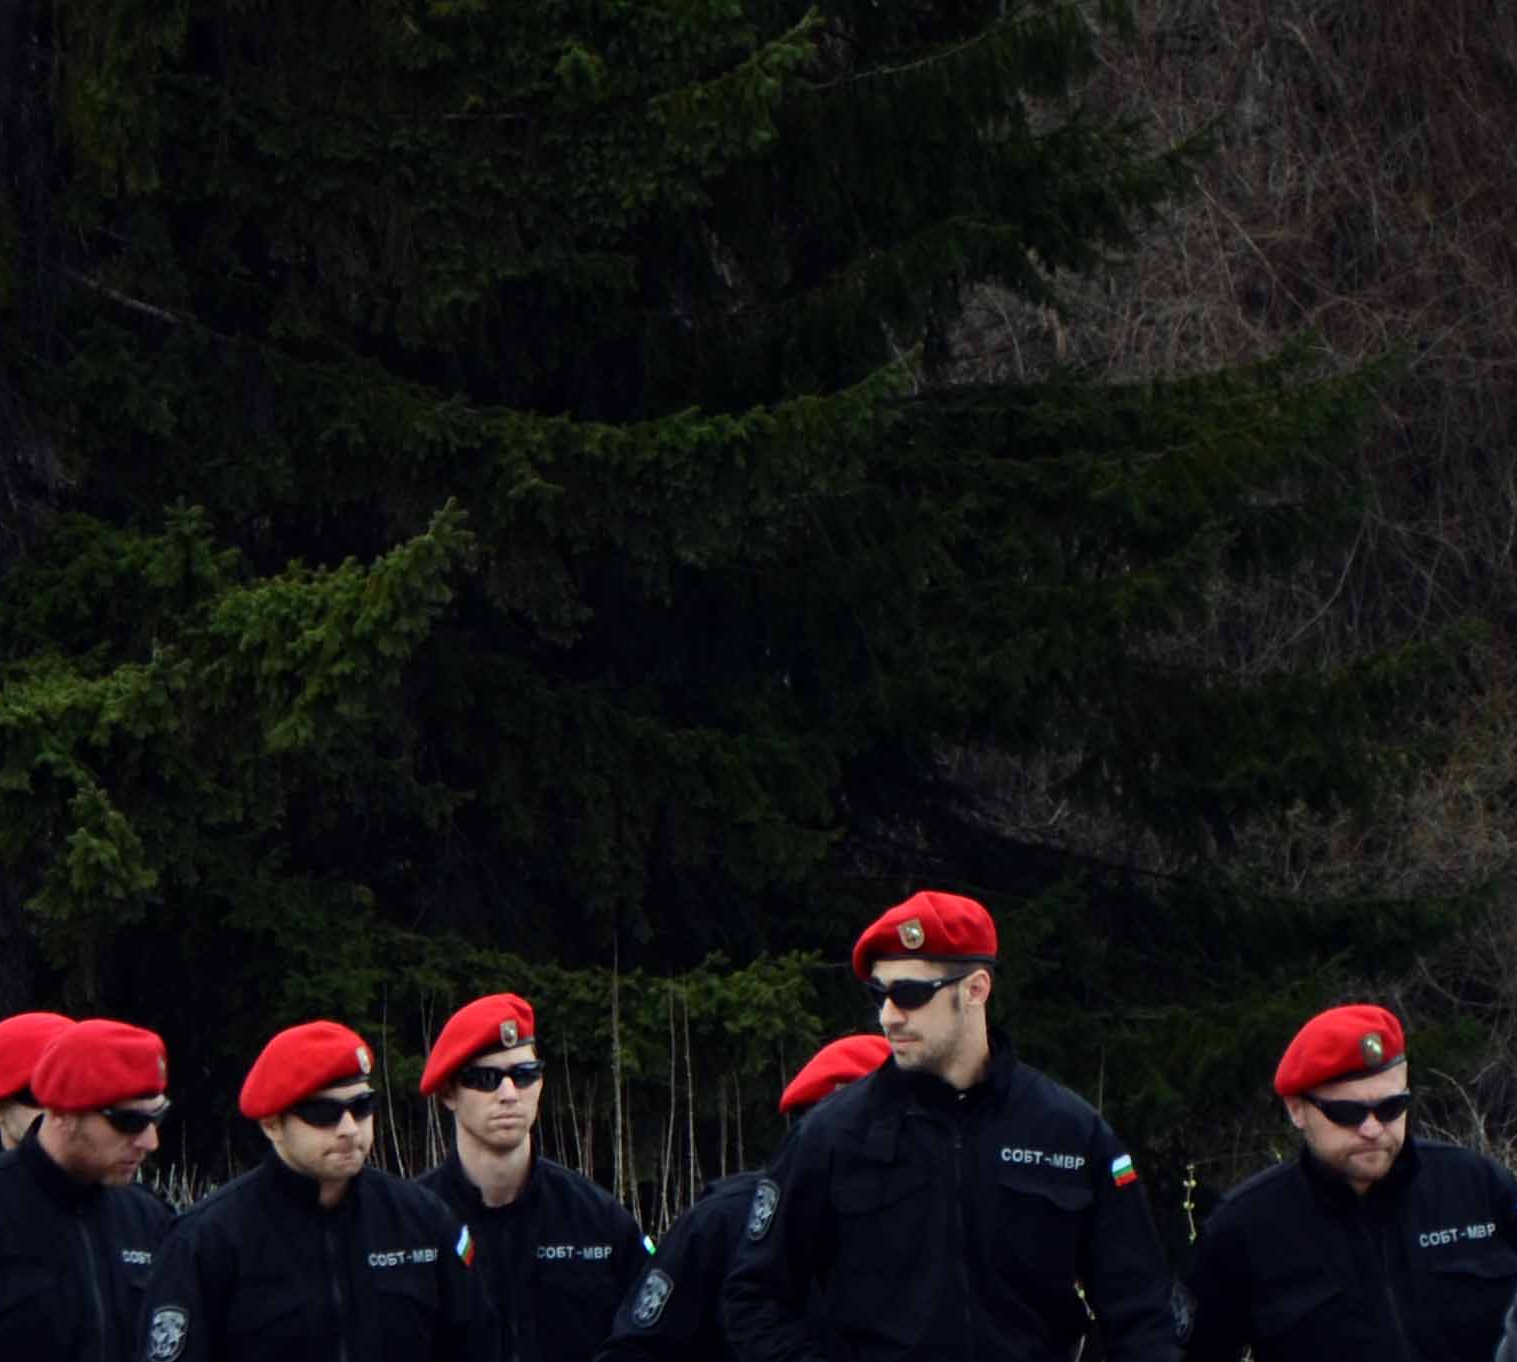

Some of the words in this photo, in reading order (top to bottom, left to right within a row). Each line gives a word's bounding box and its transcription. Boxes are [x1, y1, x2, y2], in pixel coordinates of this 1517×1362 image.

[1001, 1147, 1086, 1170] СОБТ-МВР
[1419, 1223, 1497, 1249] СОБТ-МВР
[536, 1245, 613, 1260] СОБТ-МВР
